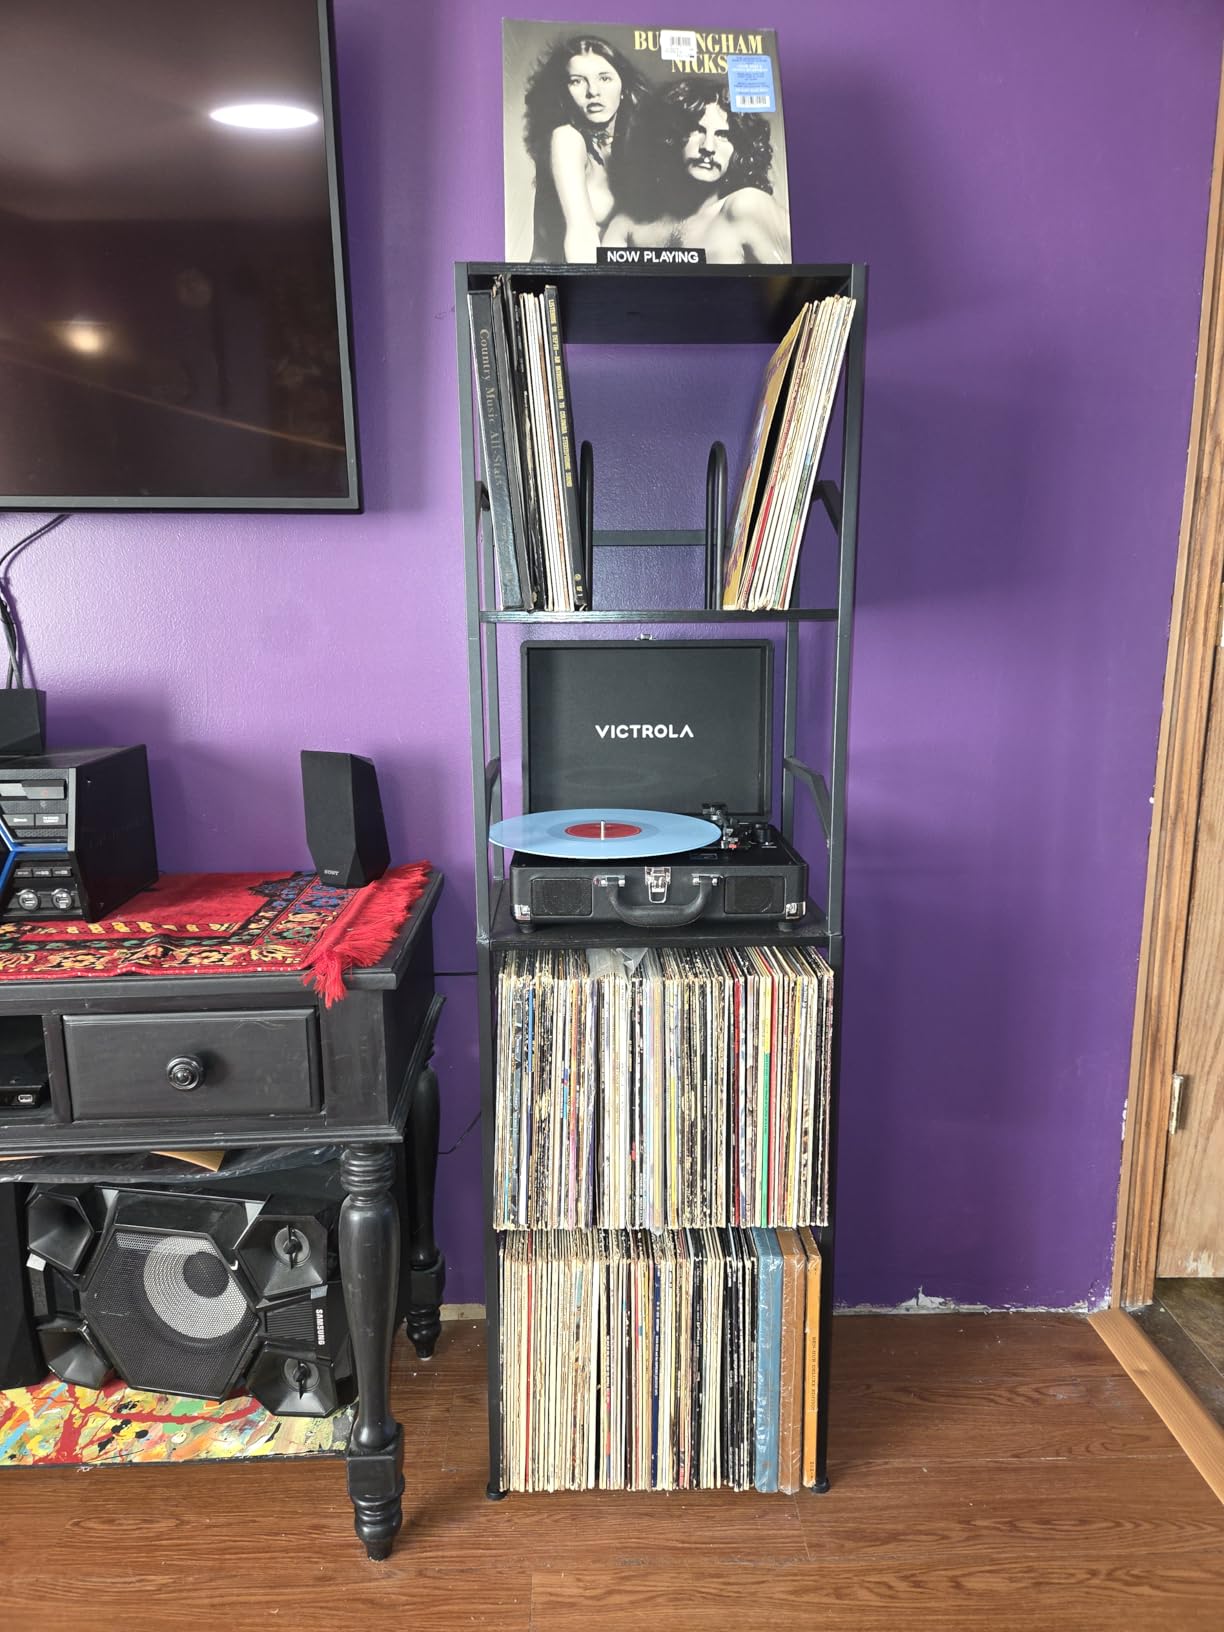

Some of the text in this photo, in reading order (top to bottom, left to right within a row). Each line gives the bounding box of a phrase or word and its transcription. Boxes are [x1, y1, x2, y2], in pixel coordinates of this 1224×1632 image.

[634, 30, 763, 54] BUNGHAM
[671, 53, 728, 74] NICKS
[607, 250, 699, 264] NOW PLAYING
[479, 328, 502, 485] Country Music All-Stars
[595, 724, 694, 739] VICTROLA
[316, 1309, 325, 1345] SAMSUNG
